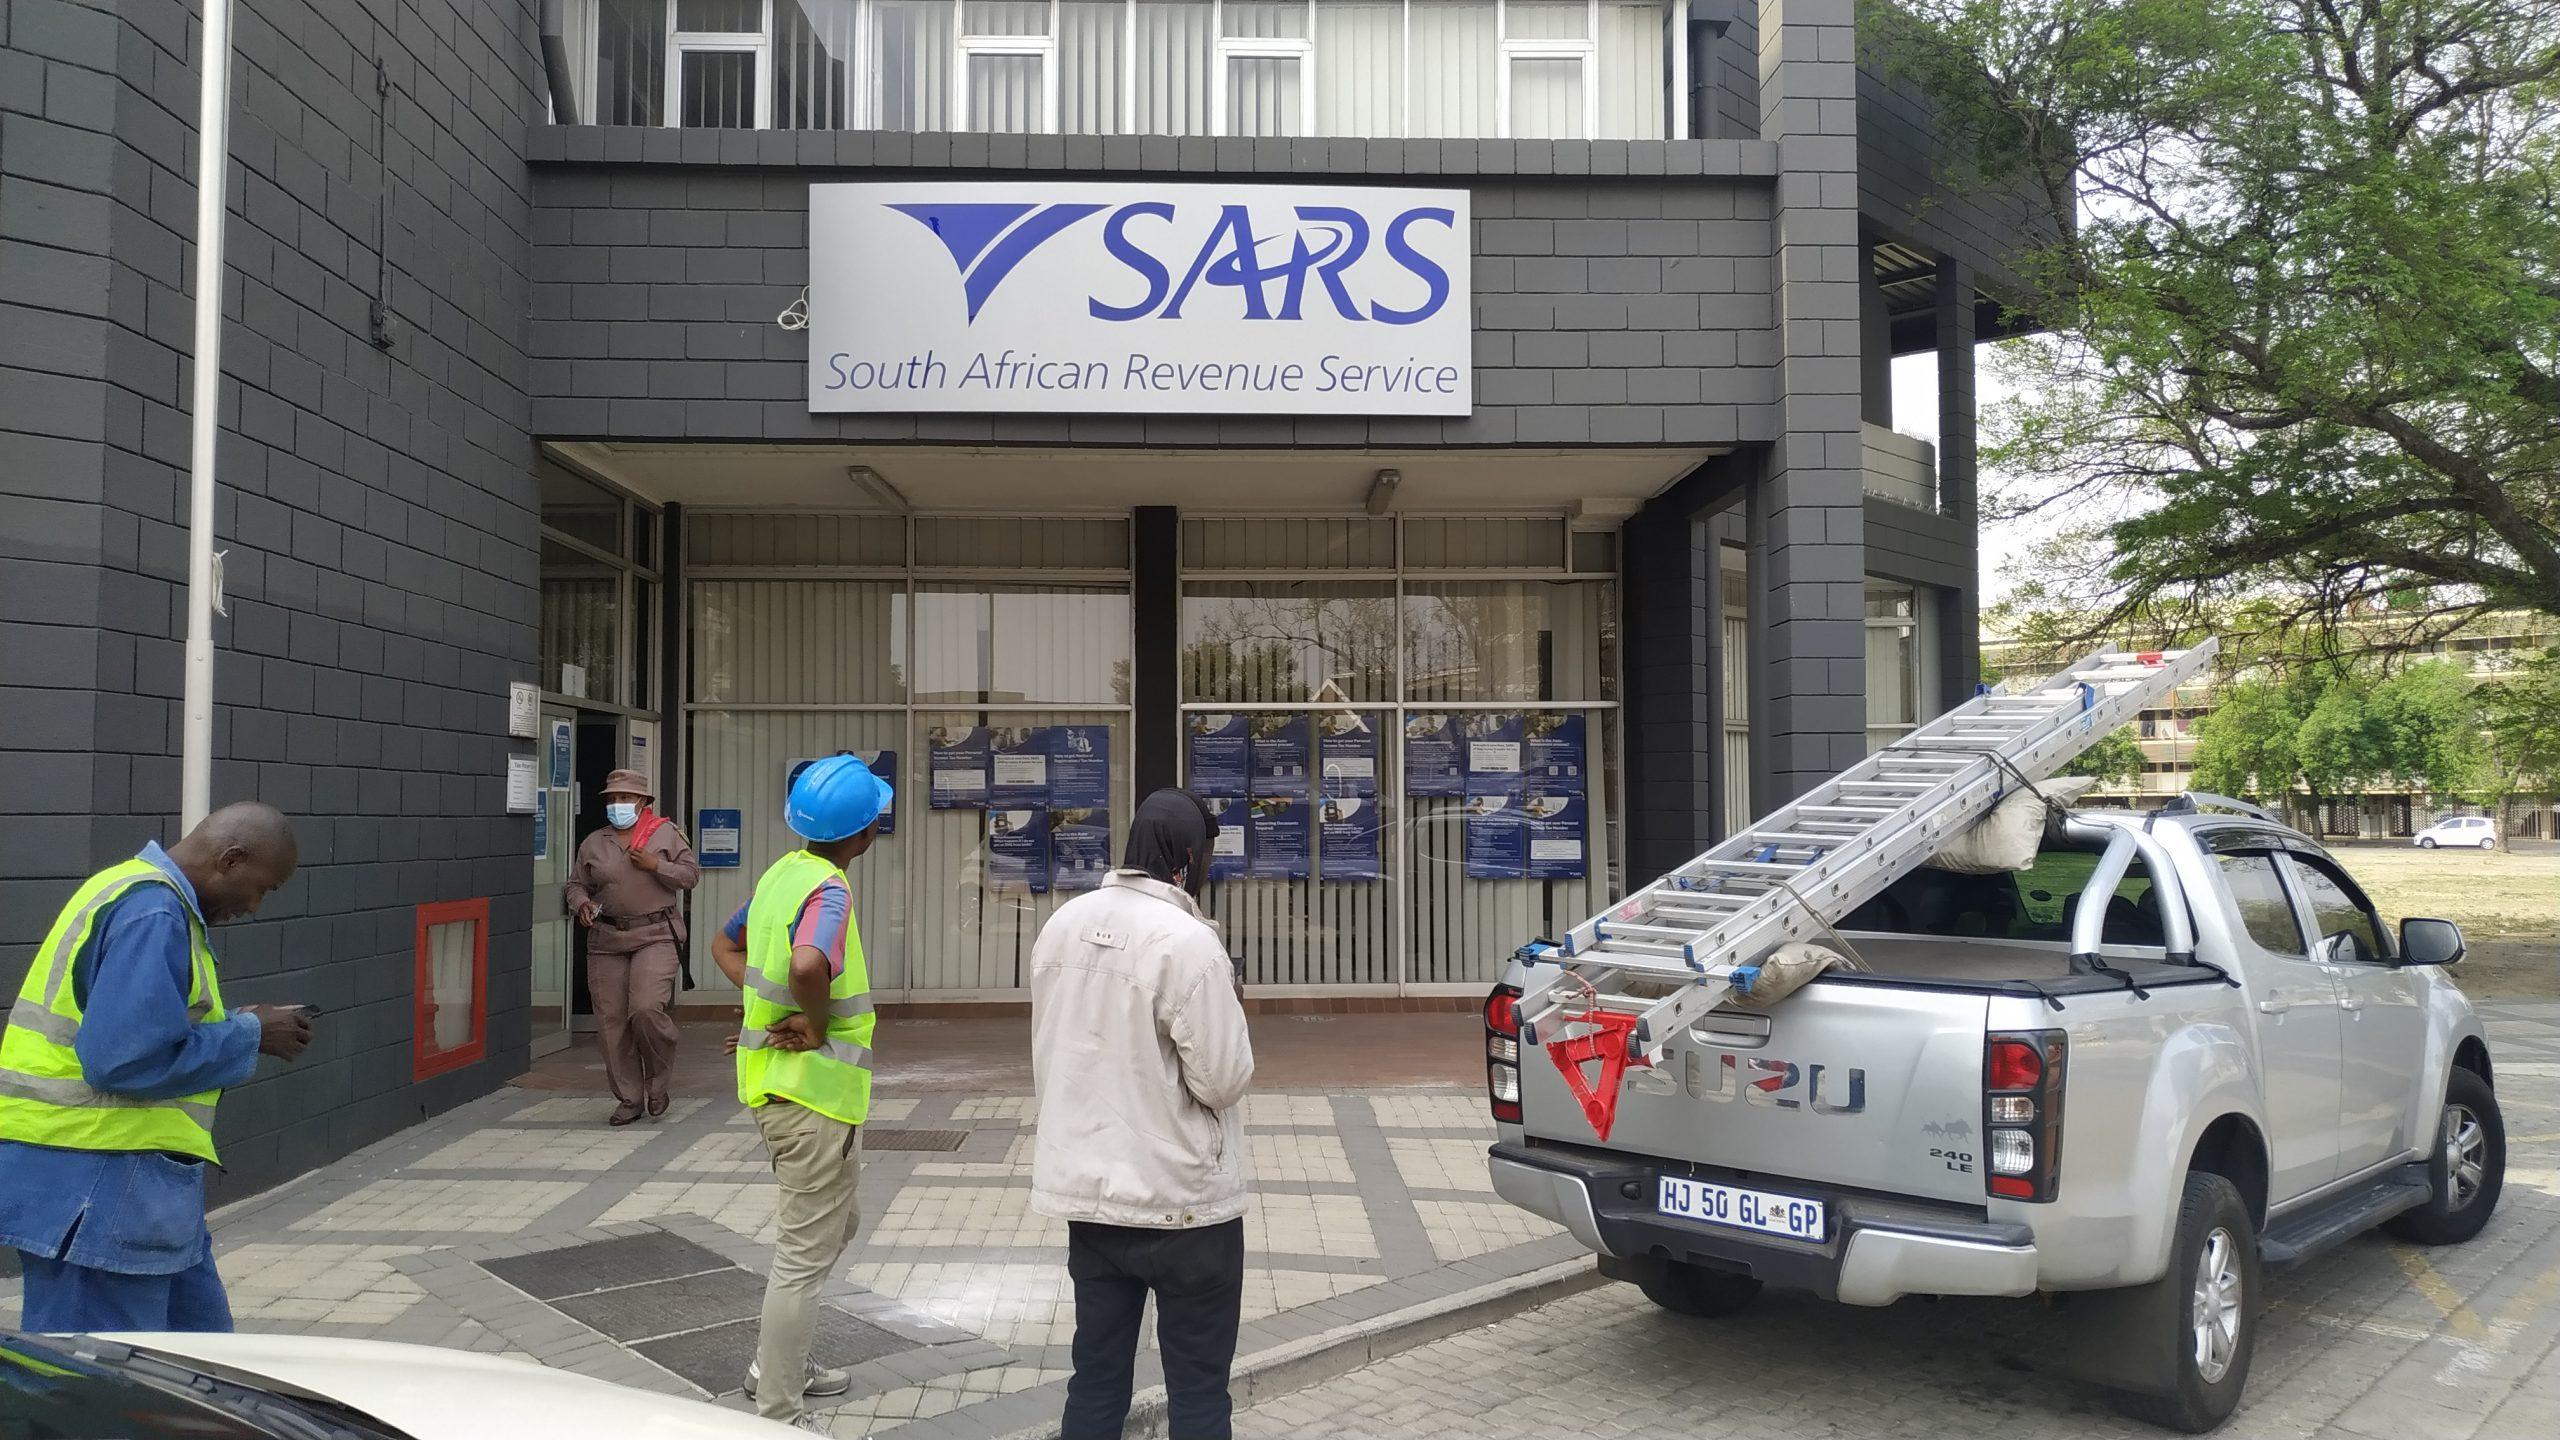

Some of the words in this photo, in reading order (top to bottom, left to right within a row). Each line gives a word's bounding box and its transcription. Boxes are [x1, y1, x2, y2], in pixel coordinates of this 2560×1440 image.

[1089, 202, 1455, 326] SARS
[825, 350, 946, 390] South
[959, 351, 1109, 391] African
[1124, 353, 1304, 391] Revenue
[1315, 354, 1459, 393] Service
[1624, 1049, 1866, 1117] SUZU
[1930, 1149, 1973, 1162] 240
[1947, 1162, 1973, 1174] LE
[1664, 1181, 1690, 1213] HJ
[1702, 1187, 1728, 1219] 50
[1739, 1194, 1767, 1226] GL
[1788, 1202, 1818, 1234] GP
